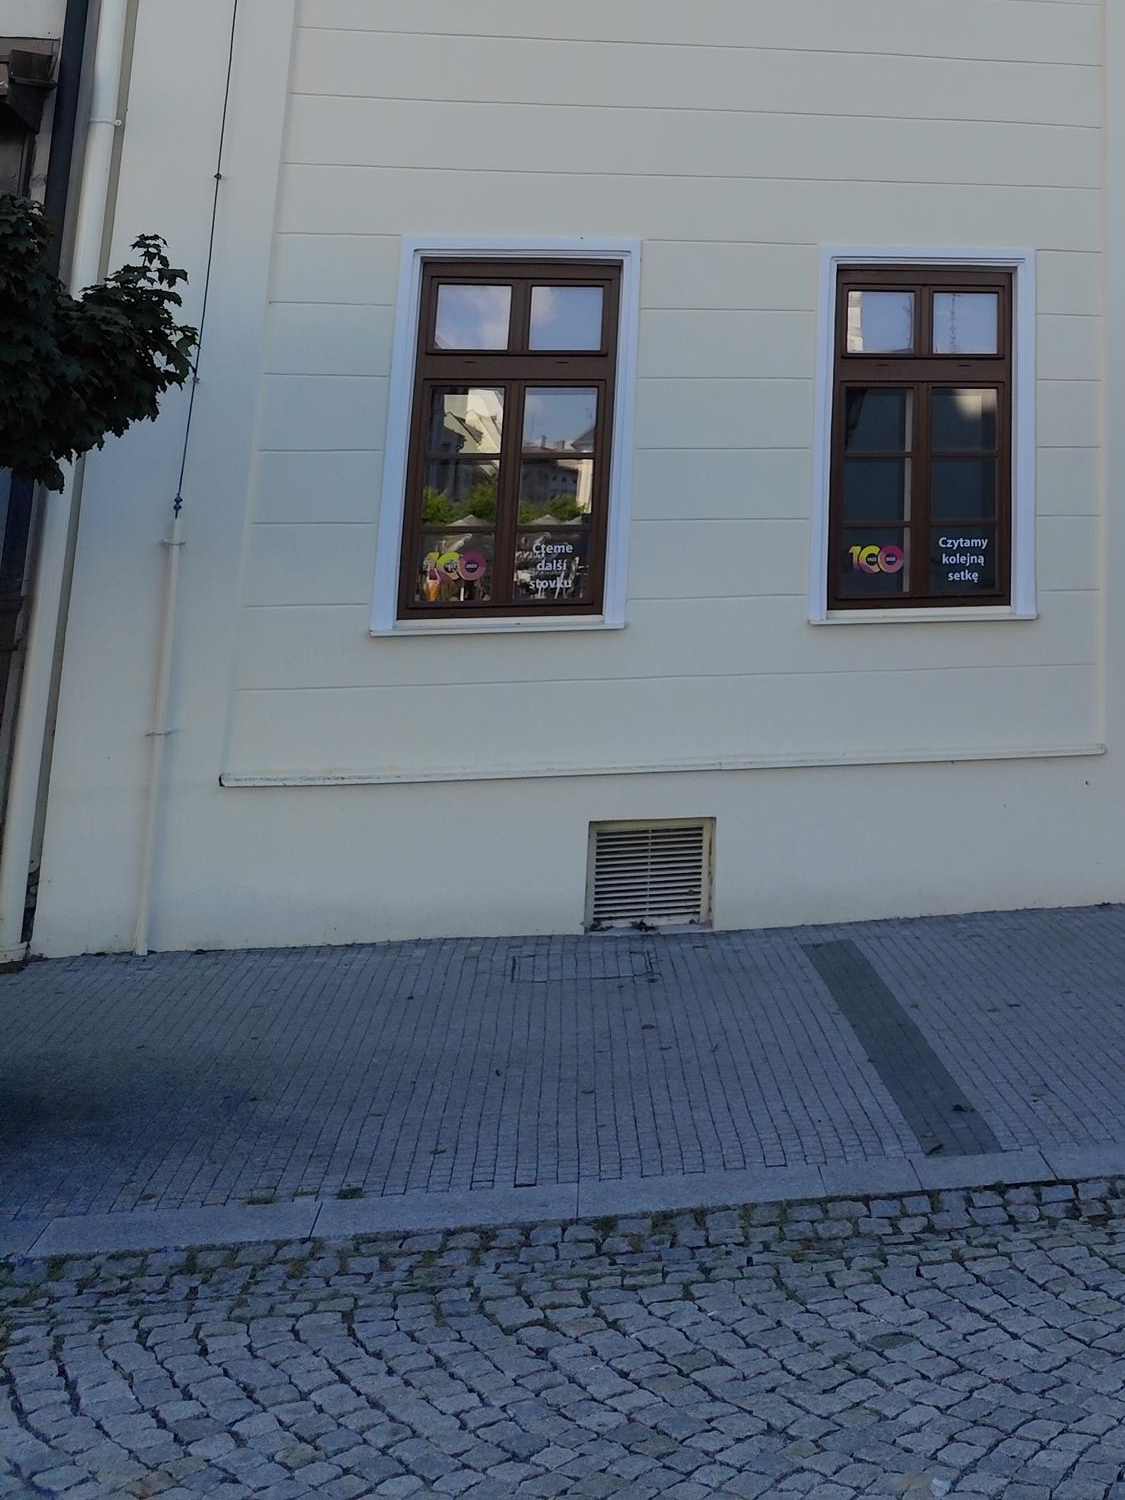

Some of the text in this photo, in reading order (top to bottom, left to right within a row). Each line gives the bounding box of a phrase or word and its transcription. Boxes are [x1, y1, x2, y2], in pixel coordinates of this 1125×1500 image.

[938, 536, 988, 550] Czytamy
[537, 559, 568, 571] další
[942, 552, 985, 567] kolejną
[528, 577, 573, 590] stovku
[947, 570, 979, 584] setkę
